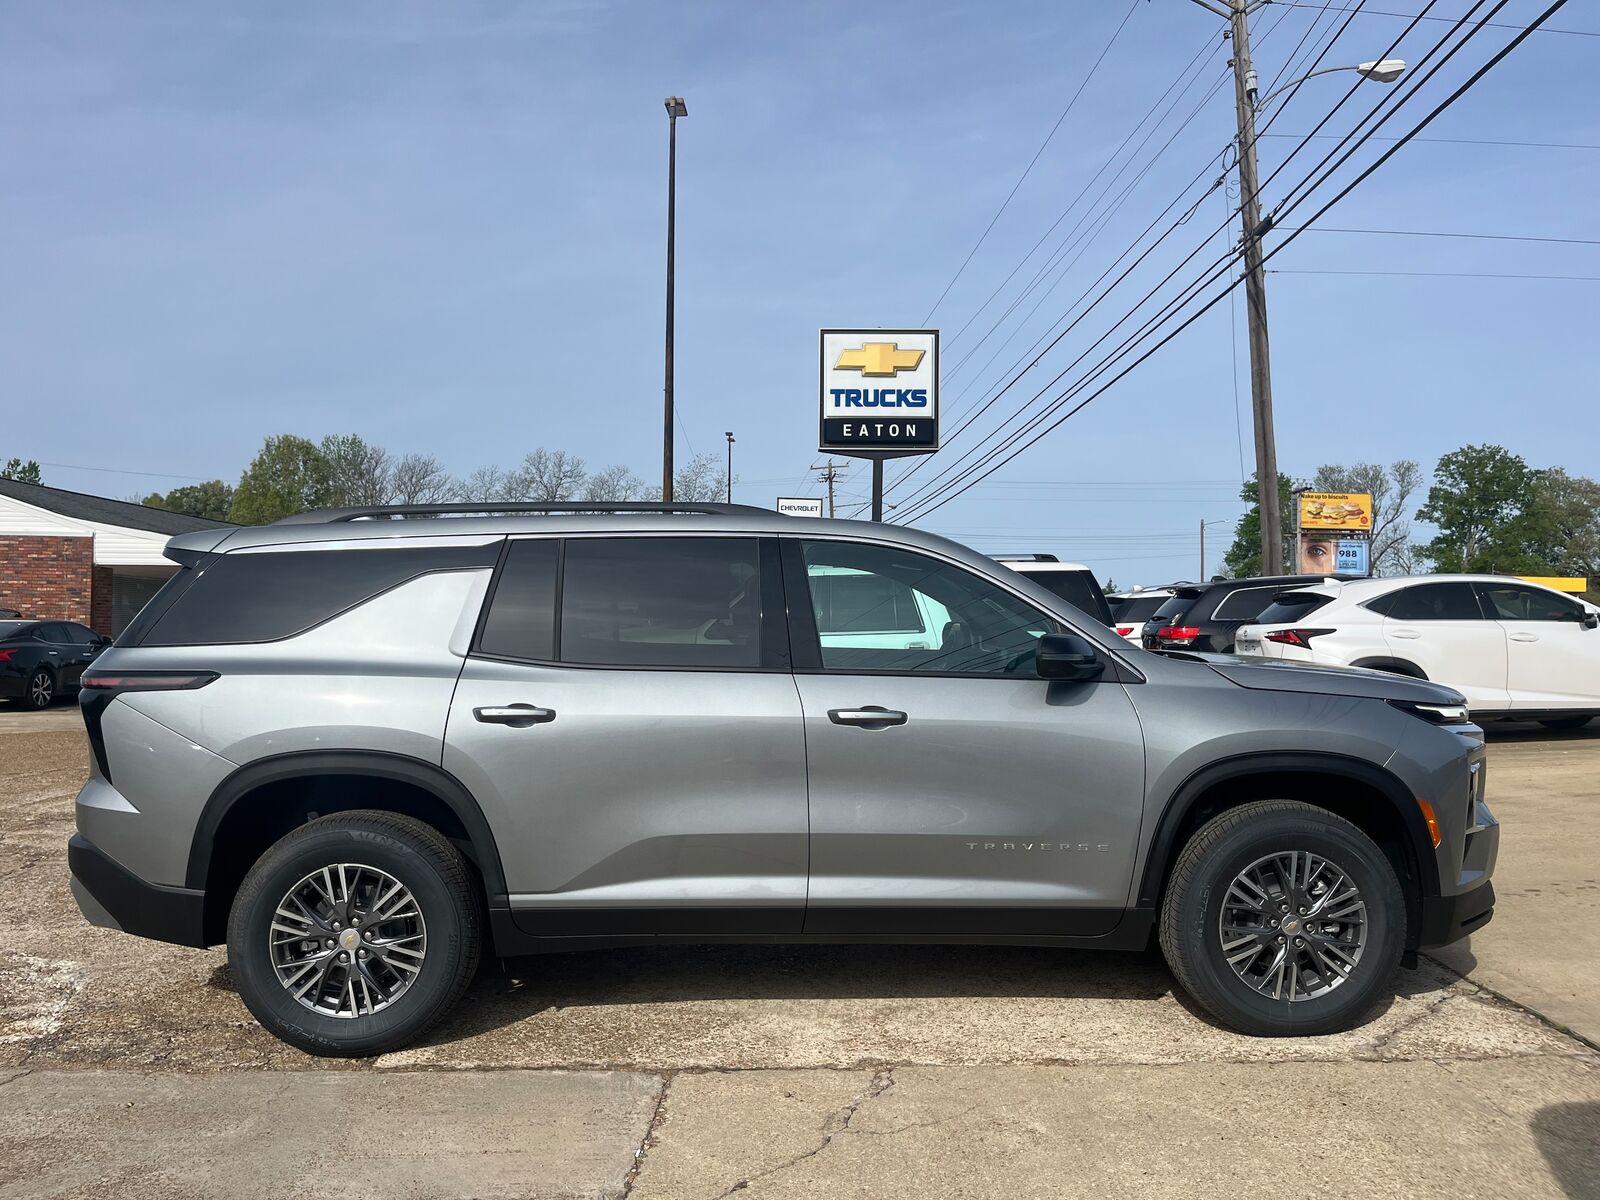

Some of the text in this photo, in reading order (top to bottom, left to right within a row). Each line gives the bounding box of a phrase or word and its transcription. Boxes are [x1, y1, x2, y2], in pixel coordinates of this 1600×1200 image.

[830, 389, 927, 407] TRUCKS
[843, 424, 916, 437] EATON
[966, 842, 1110, 852] TRAVERSE
